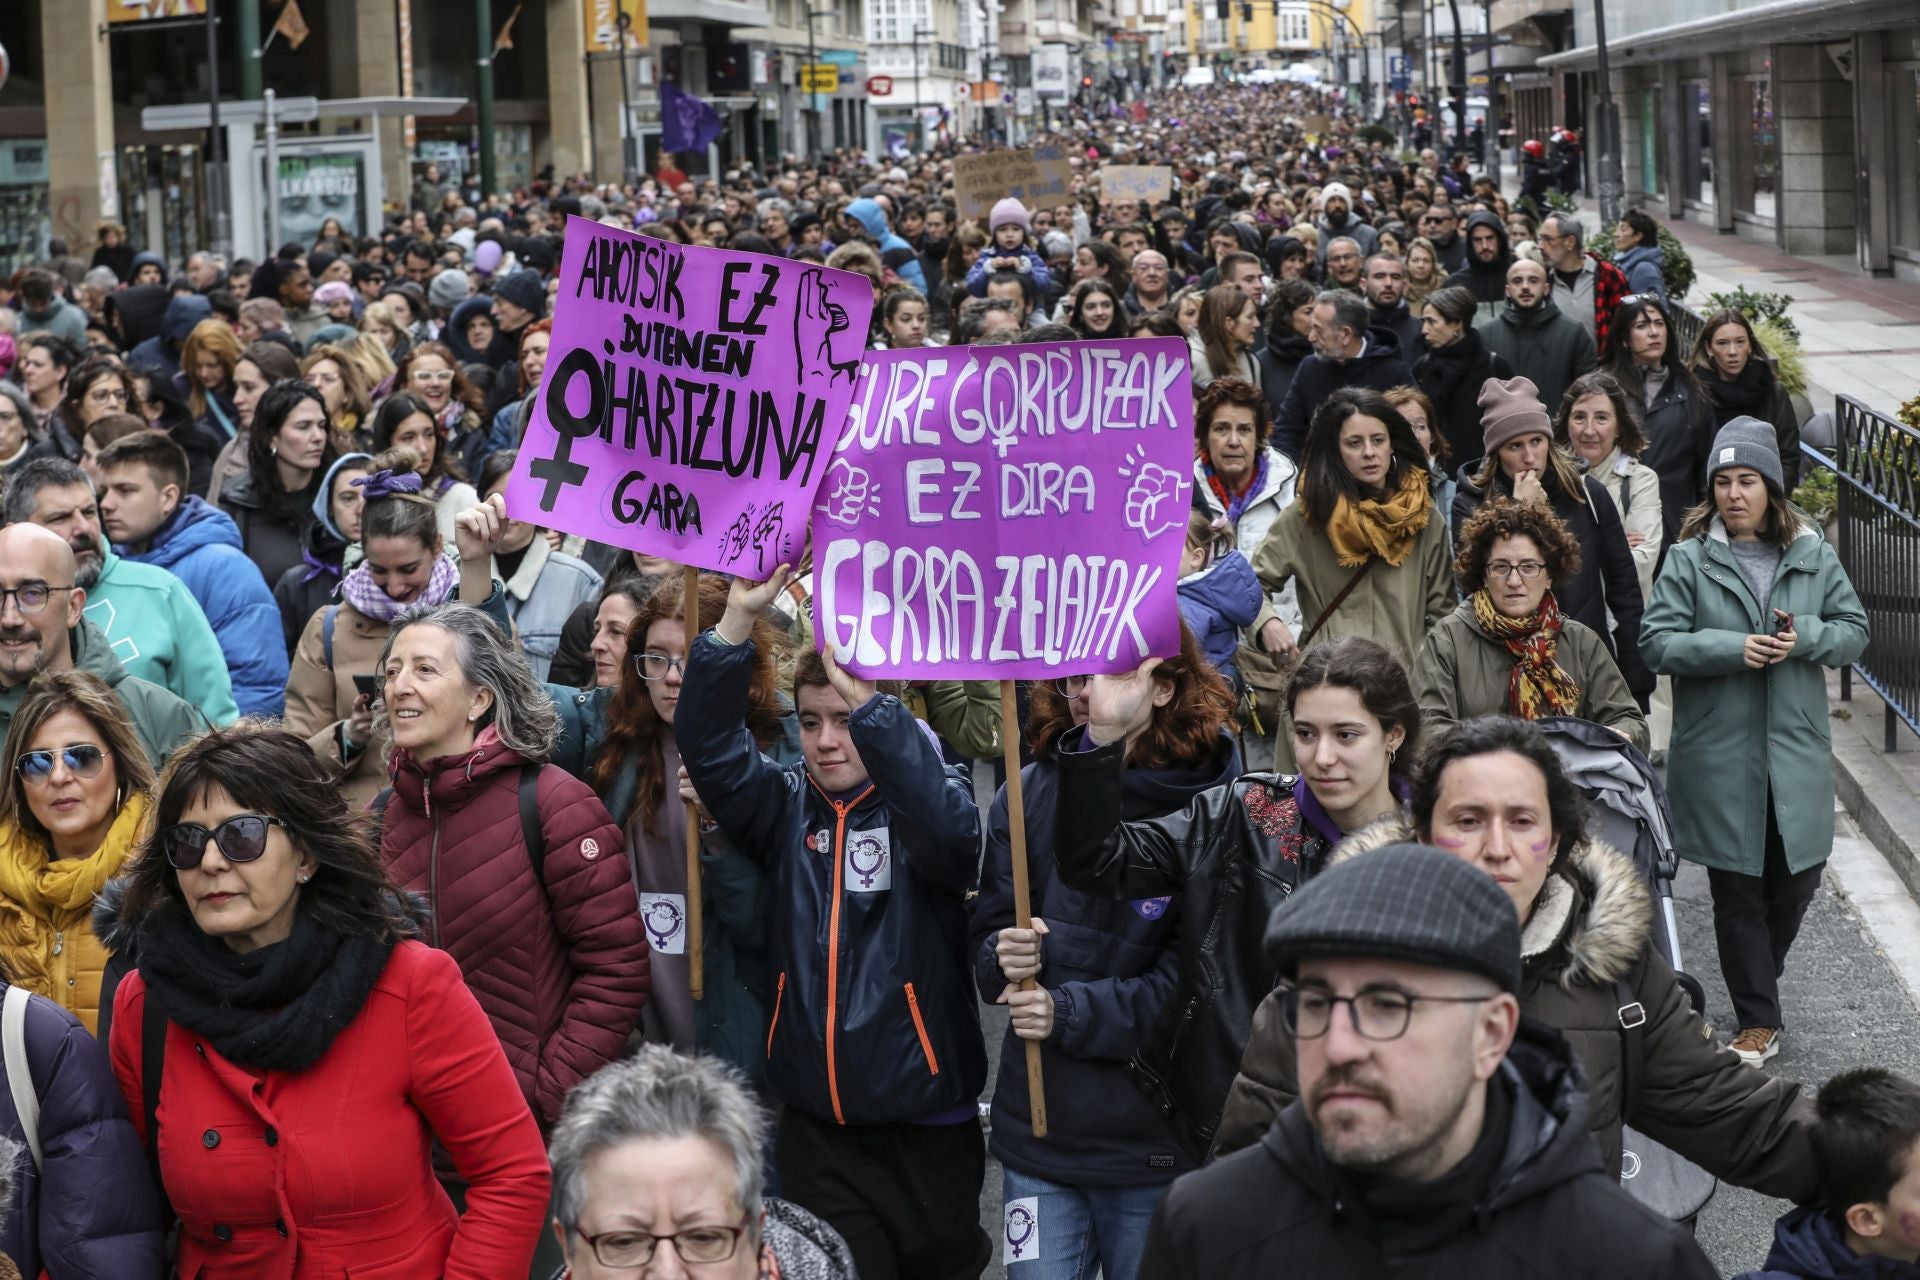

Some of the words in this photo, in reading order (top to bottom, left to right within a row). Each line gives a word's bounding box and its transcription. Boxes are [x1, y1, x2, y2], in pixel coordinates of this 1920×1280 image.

[718, 262, 780, 336] EZ
[620, 314, 756, 378] DUTENEN
[611, 470, 703, 536] GARA
[907, 458, 982, 522] EZ
[1001, 461, 1095, 518] DIRA
[821, 538, 984, 666] GERRA
[989, 554, 1162, 665] ZELATAK
